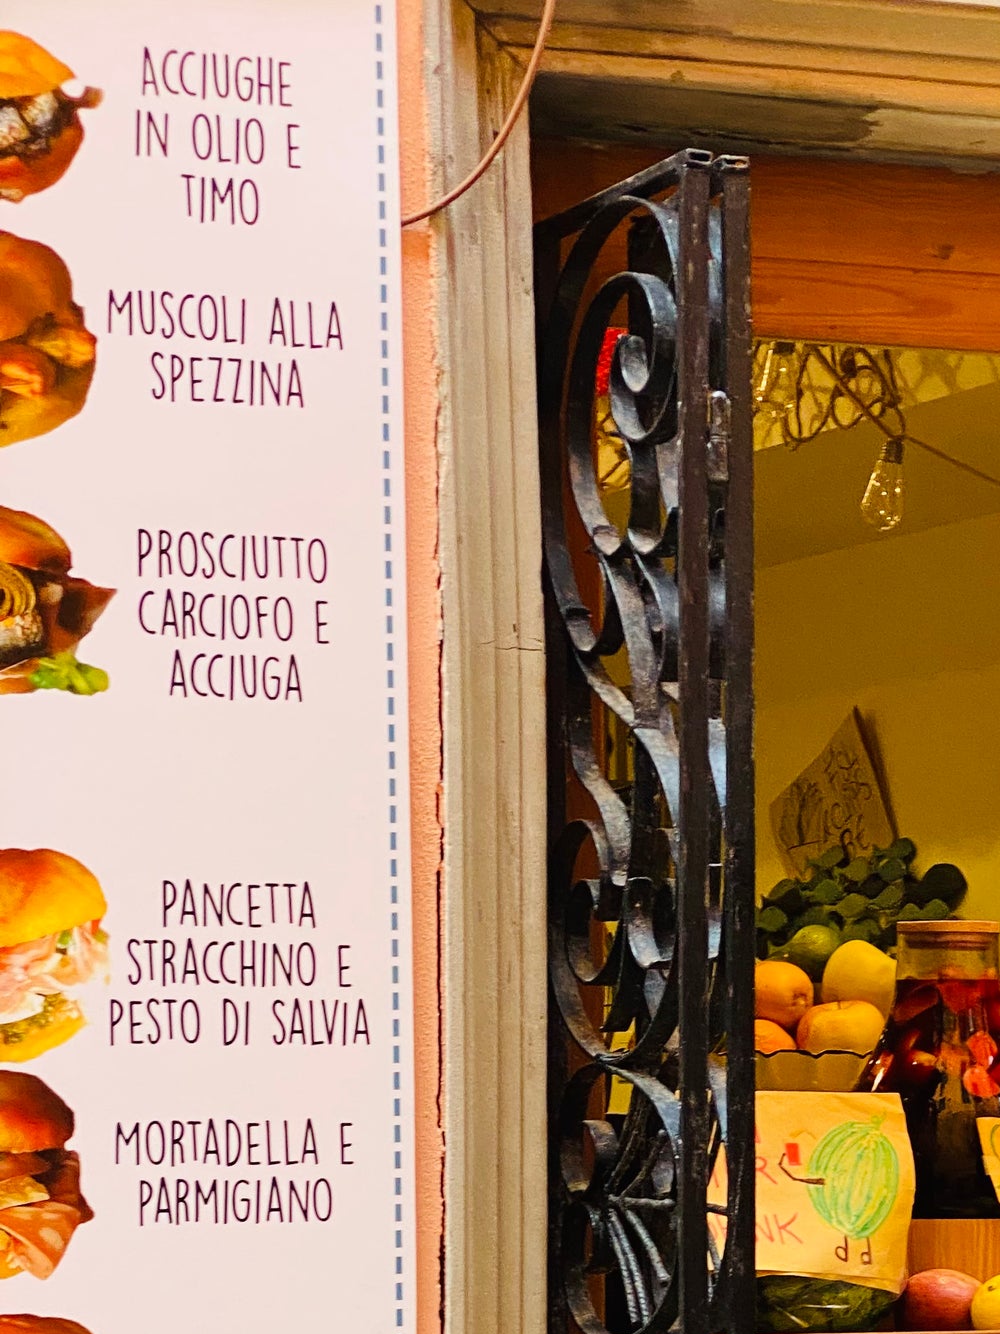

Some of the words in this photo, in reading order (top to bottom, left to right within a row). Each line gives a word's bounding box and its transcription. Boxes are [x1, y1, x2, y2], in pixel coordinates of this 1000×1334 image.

[141, 45, 293, 108] ACCIUGHE
[135, 108, 169, 158] IN
[191, 112, 265, 165] OLIO
[286, 123, 302, 170] E
[180, 173, 260, 226] TIMO
[107, 288, 246, 345] MUSCOLI
[268, 296, 344, 351] ALLA
[150, 351, 305, 409] SPEZZINA
[137, 527, 328, 585] PROSCIUTTO
[137, 587, 294, 642] CARCIOFO
[314, 599, 331, 645] E
[168, 648, 303, 703] ACCIUGA
[161, 878, 317, 929] PANCETTA
[126, 937, 317, 988] STRACCHINO
[337, 944, 353, 988] E
[109, 997, 201, 1047] PESTO
[222, 997, 251, 1047] DI
[271, 997, 371, 1047] SALVIA
[115, 1117, 319, 1168] MORTADELLA
[339, 1122, 355, 1166] E
[139, 1175, 333, 1227] PARMIGIANO
